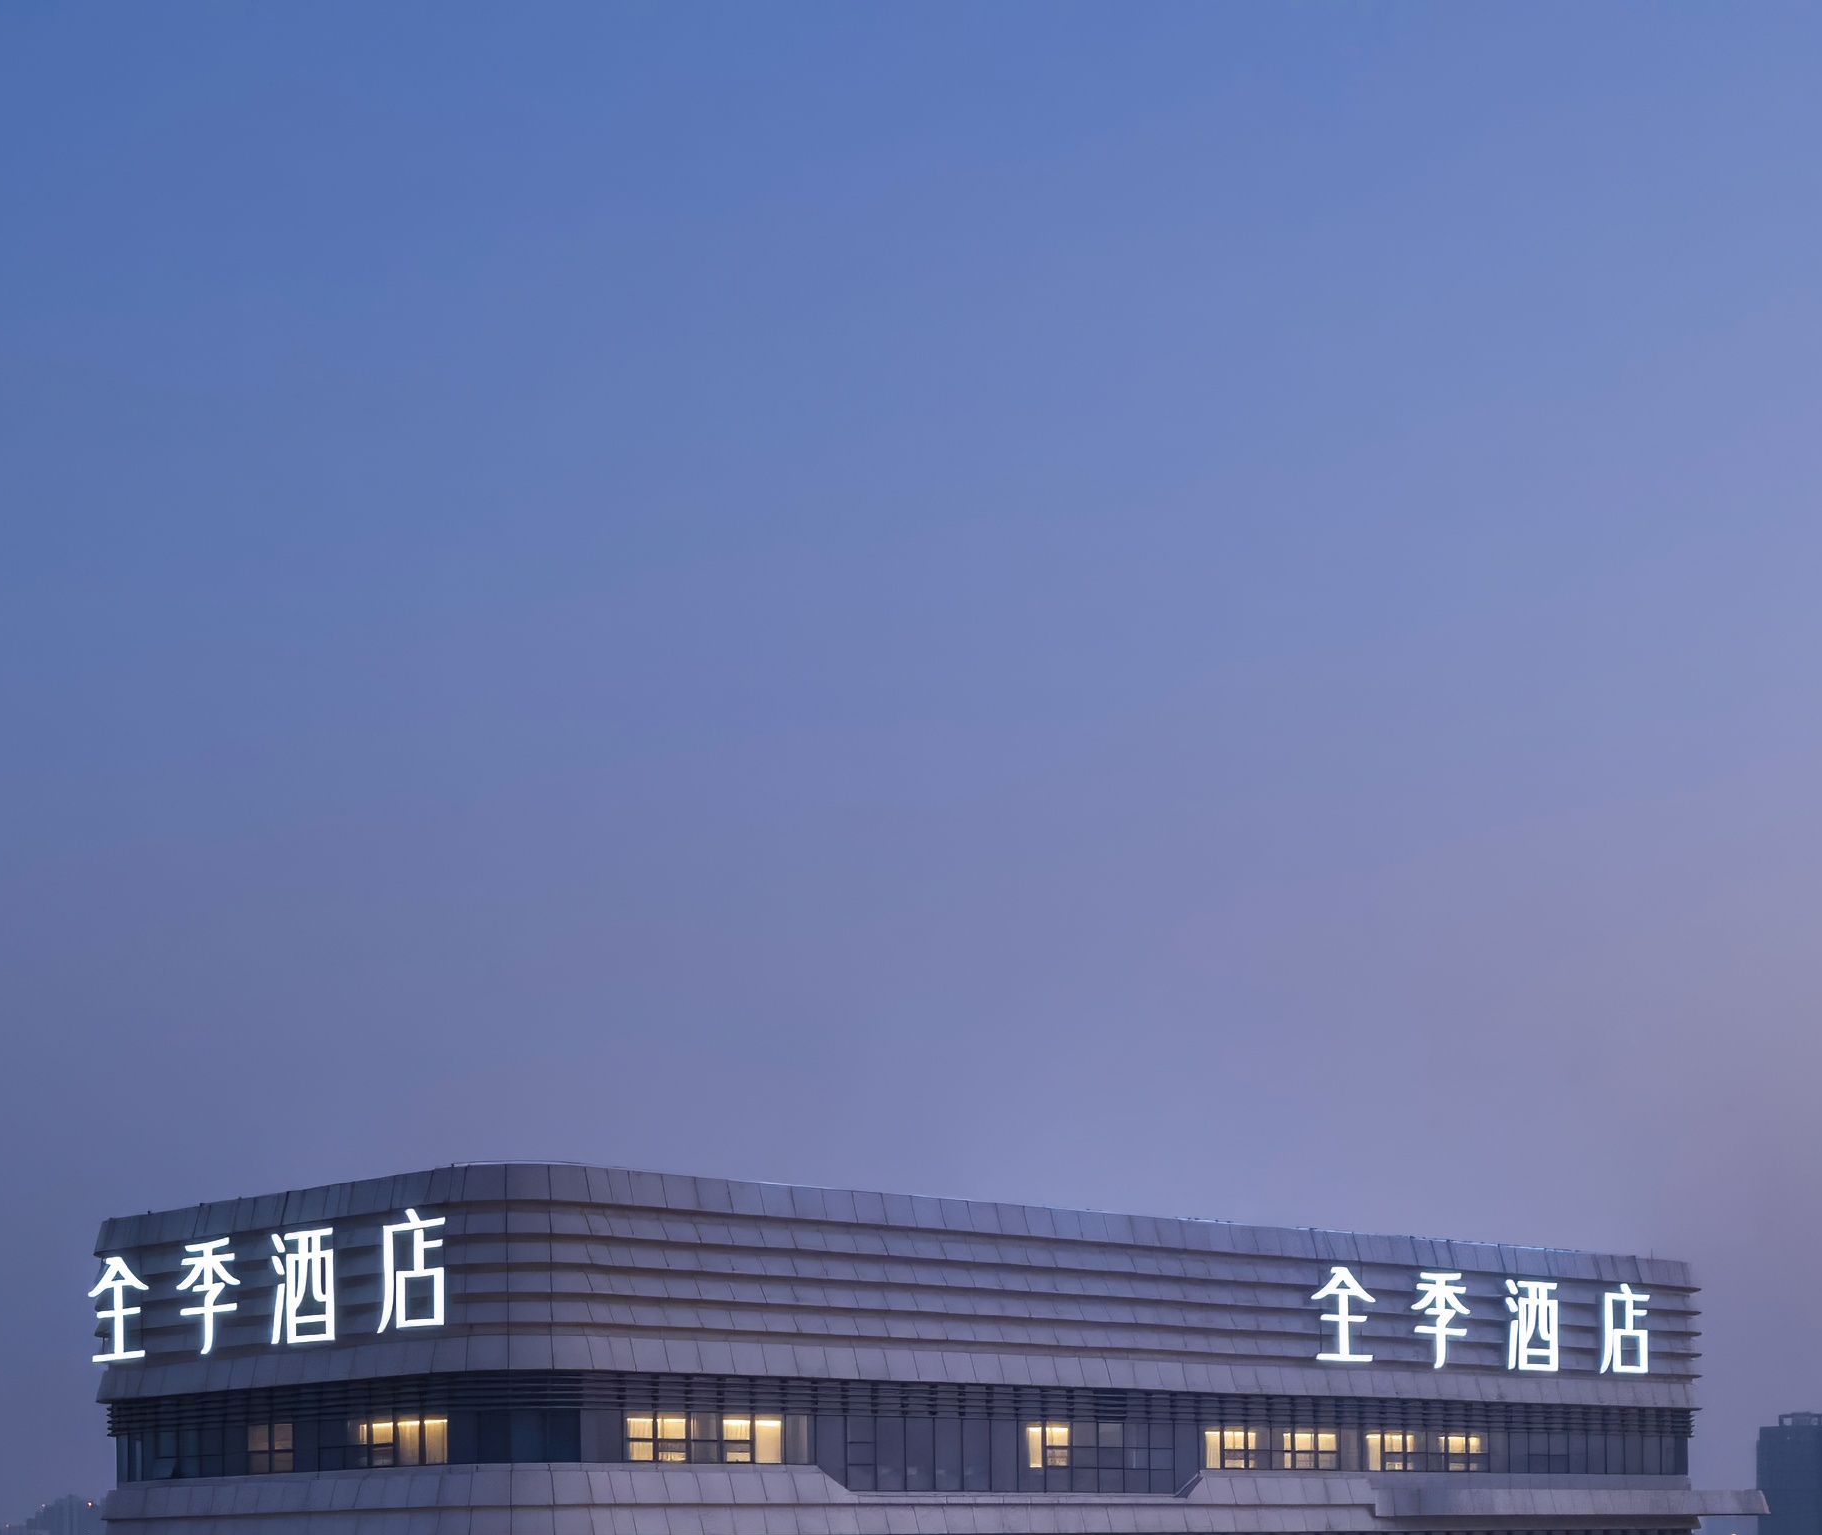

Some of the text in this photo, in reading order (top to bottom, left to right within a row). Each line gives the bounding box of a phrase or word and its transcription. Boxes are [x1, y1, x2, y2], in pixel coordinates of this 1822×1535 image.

[87, 1208, 446, 1363] 全季酒店
[1310, 1266, 1651, 1374] 全季酒店
